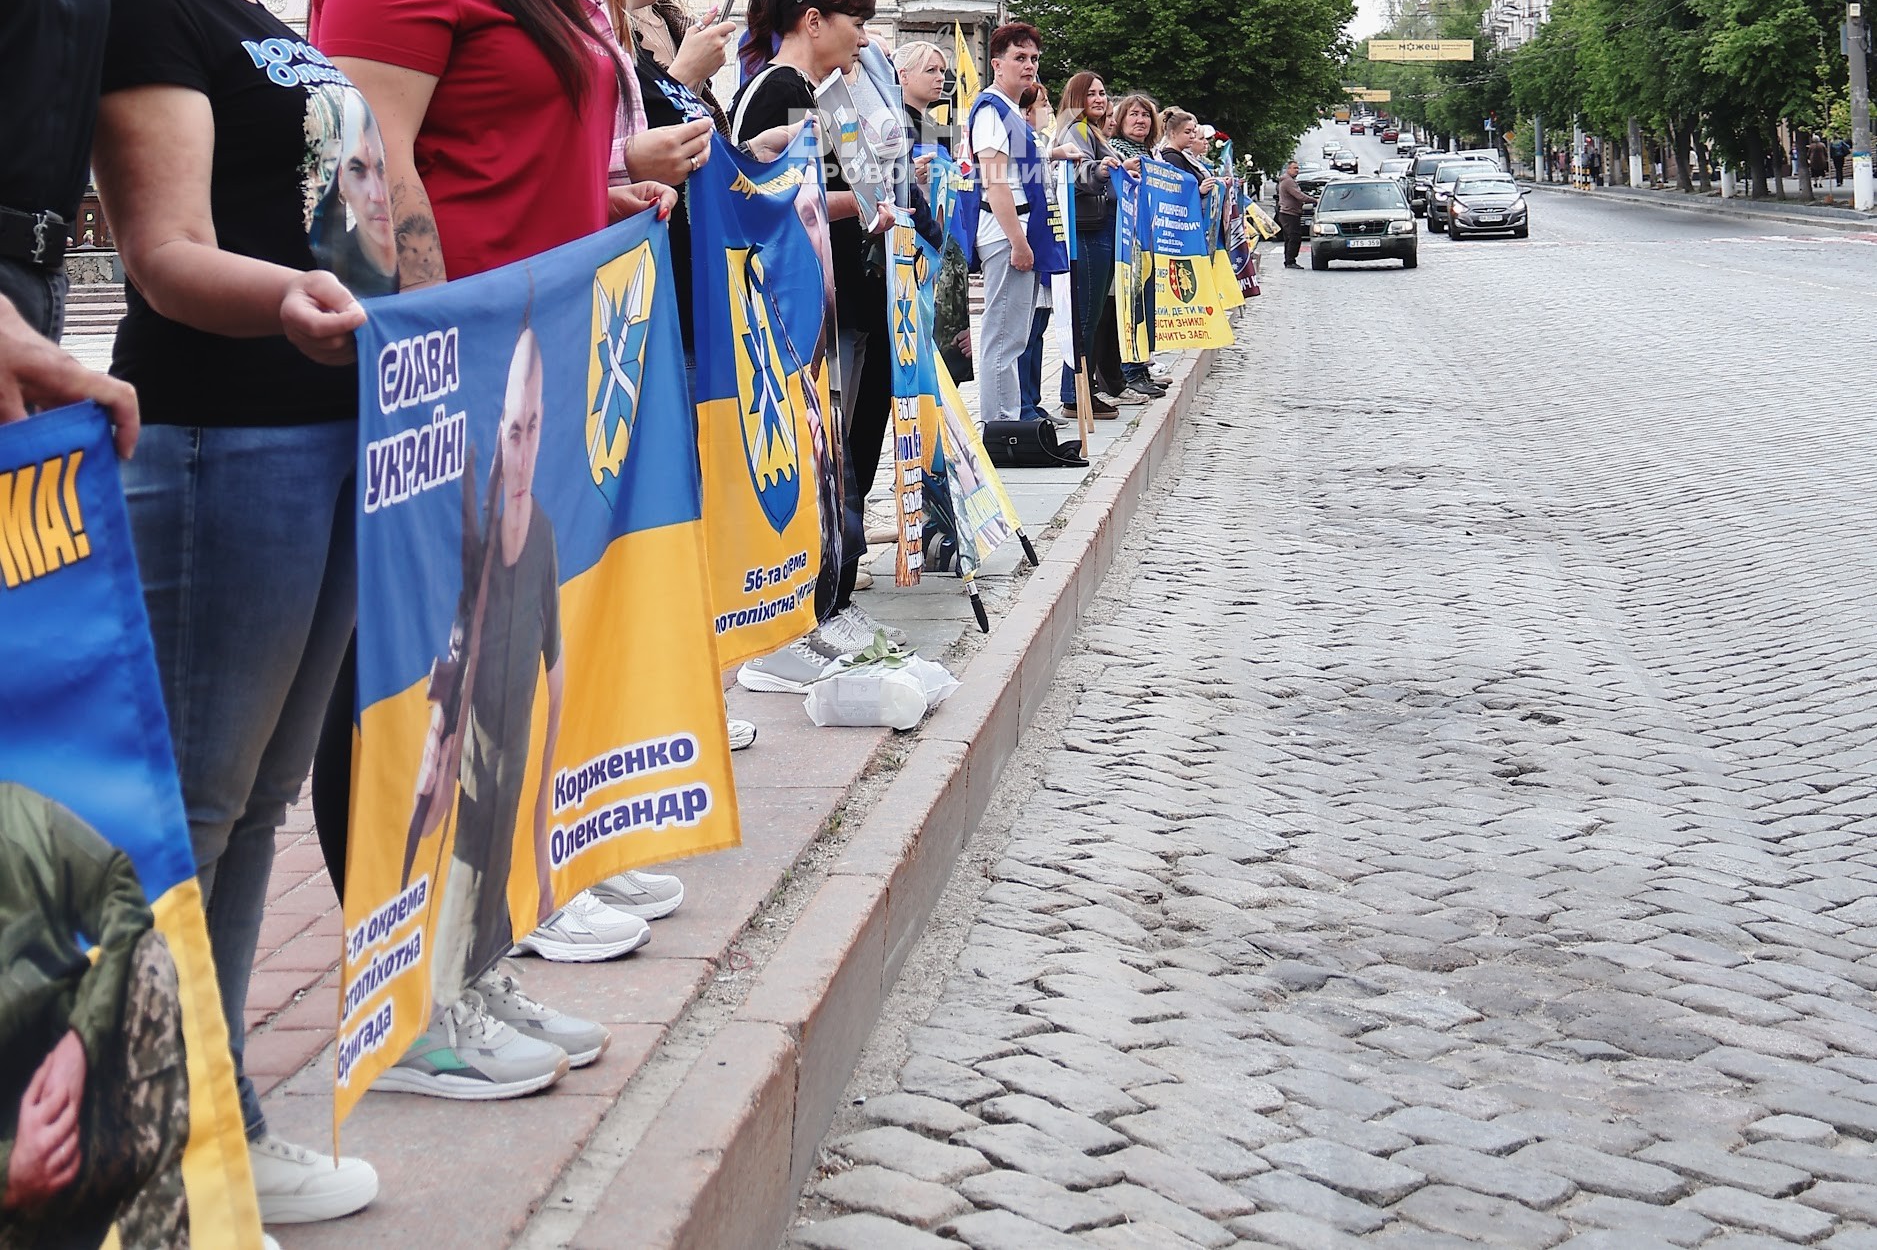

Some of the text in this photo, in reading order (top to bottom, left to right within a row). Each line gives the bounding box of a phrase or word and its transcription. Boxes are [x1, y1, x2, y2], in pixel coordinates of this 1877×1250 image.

[1367, 239, 1380, 247] 359
[378, 327, 460, 414] СЛАВА
[364, 404, 466, 514] УКРАЇНІ
[742, 567, 782, 594] 56-та
[552, 733, 699, 815] Корженко
[549, 782, 713, 870] Олександр
[365, 873, 428, 950] окрема
[336, 998, 393, 1088] бригада
